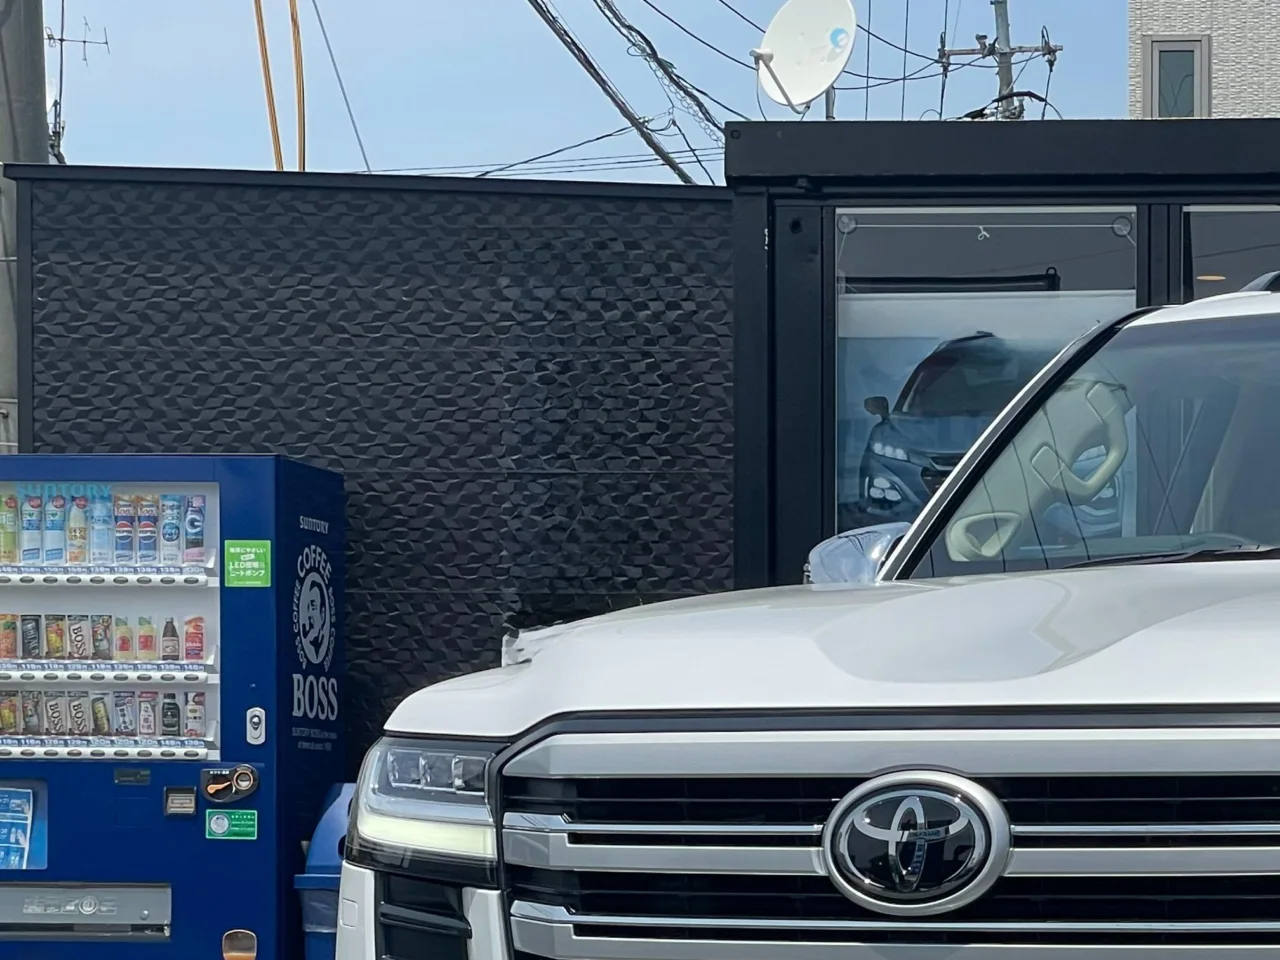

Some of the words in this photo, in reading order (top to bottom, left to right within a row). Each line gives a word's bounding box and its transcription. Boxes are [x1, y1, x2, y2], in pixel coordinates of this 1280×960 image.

[300, 516, 329, 534] SUNTORY
[298, 545, 332, 584] COFFEE
[72, 626, 87, 656] BOSS
[292, 673, 338, 721] BOSS
[49, 703, 63, 732] BOSS
[72, 703, 87, 732] BOSS
